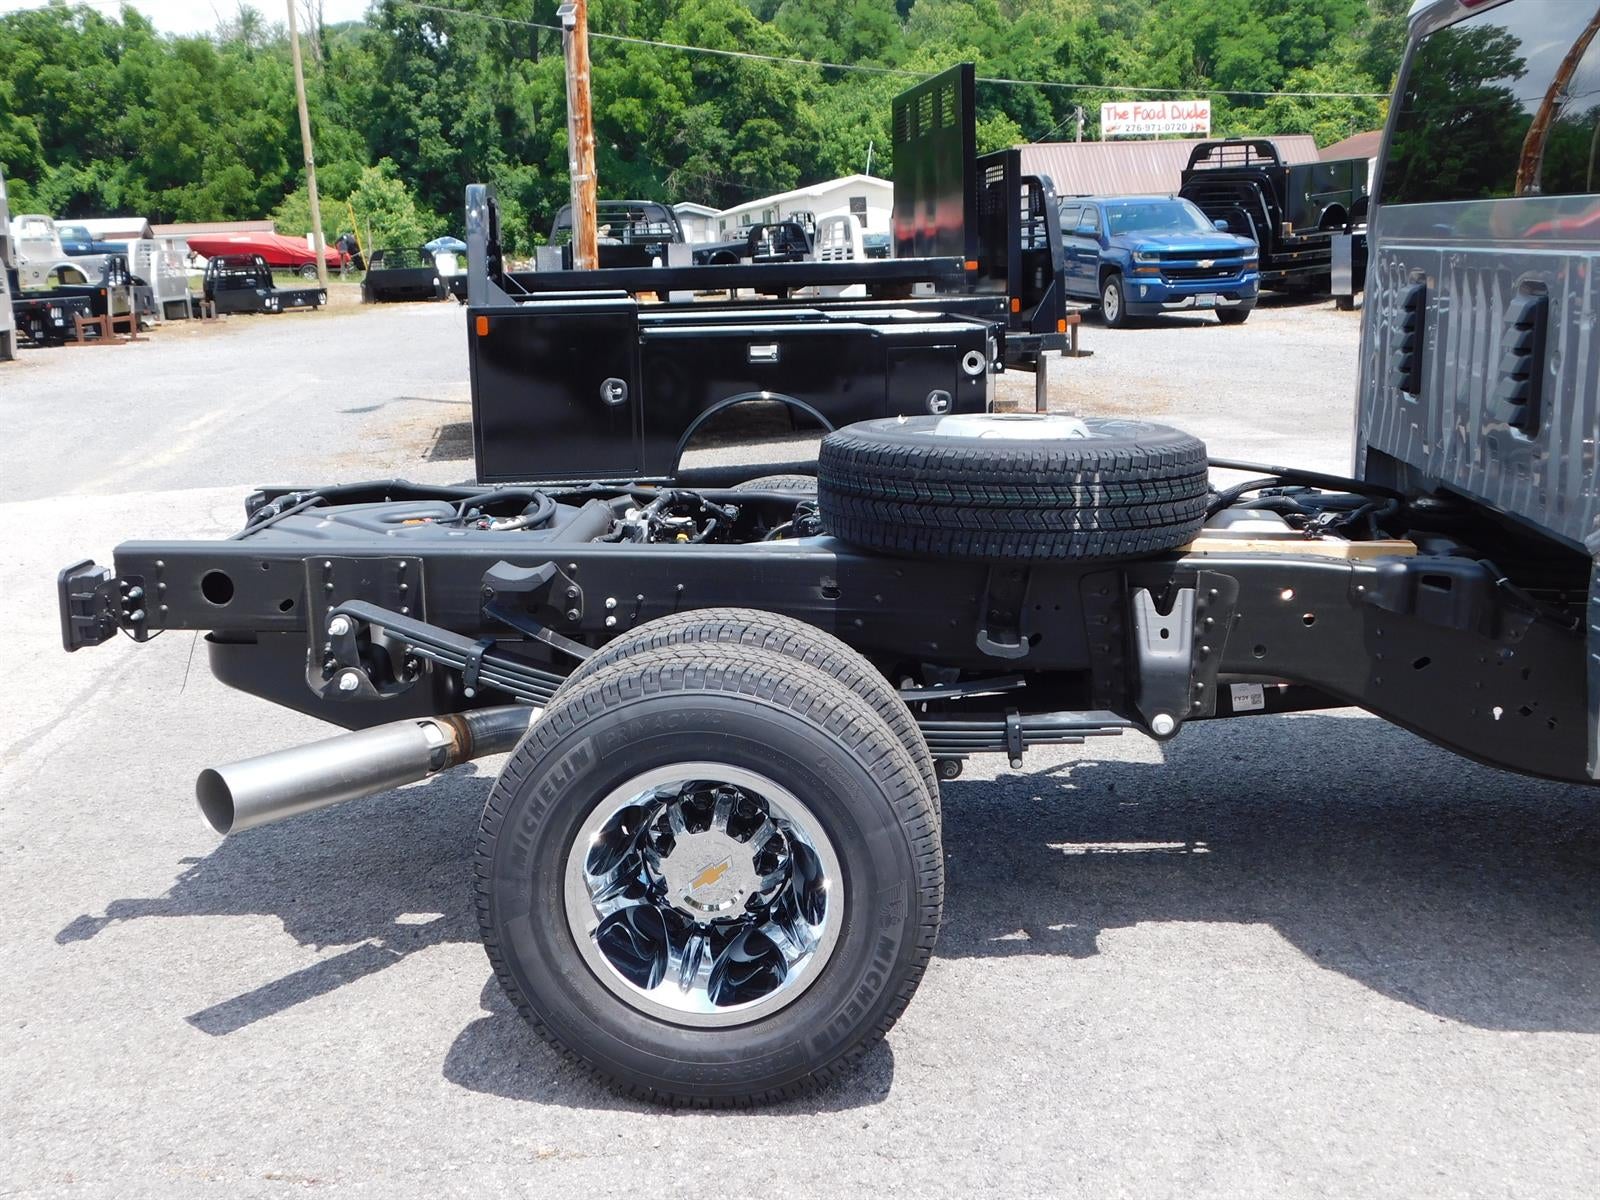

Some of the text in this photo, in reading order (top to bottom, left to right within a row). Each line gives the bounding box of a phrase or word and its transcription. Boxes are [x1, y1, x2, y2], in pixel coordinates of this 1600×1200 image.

[1104, 103, 1208, 122] The Food Dude
[510, 746, 589, 867] MICHELIN
[811, 934, 896, 1054] MICHELIN
